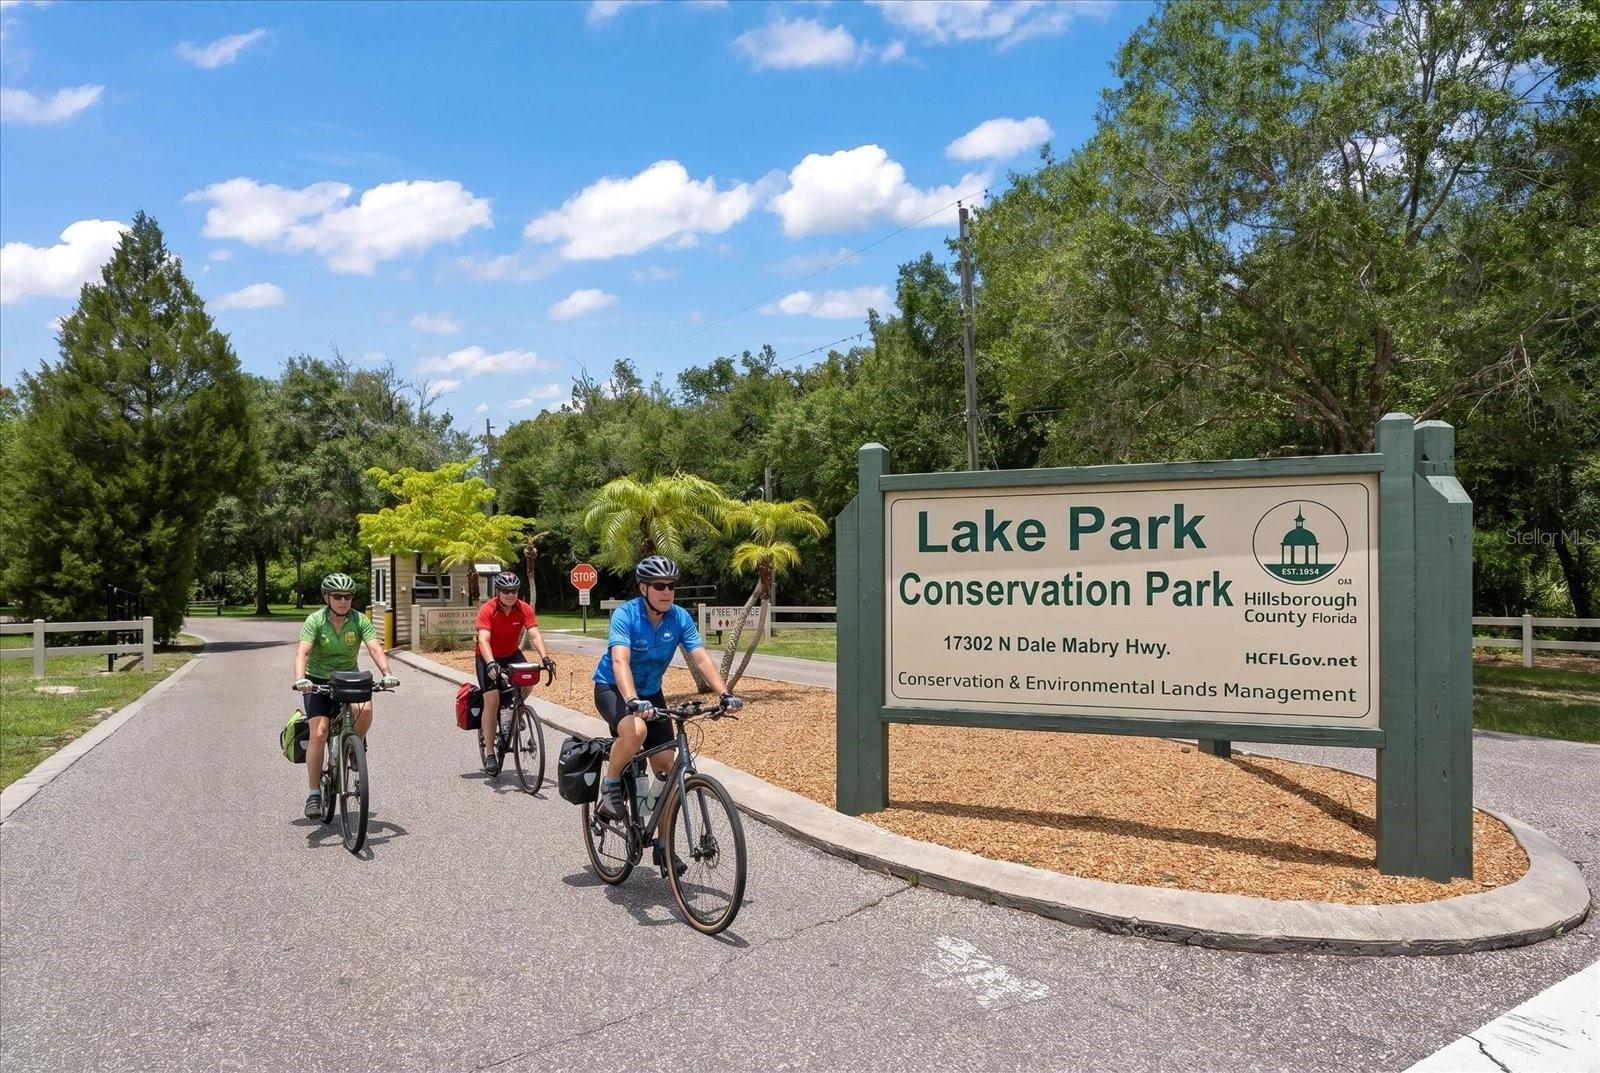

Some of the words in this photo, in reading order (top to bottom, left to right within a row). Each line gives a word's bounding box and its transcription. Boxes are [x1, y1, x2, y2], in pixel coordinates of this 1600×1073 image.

[918, 508, 1047, 554] Lake
[1069, 503, 1208, 551] Park
[573, 572, 596, 582] STOP
[899, 571, 1131, 607] Conservation
[1146, 570, 1234, 607] Park
[1244, 591, 1358, 610] Hillsborough
[1244, 609, 1307, 628] County
[1312, 612, 1358, 625] Florida
[943, 635, 993, 652] 17302
[998, 636, 1011, 652] N
[1017, 636, 1057, 653] Dale
[1062, 637, 1120, 658] Mabry
[1126, 638, 1171, 660] Hwy.
[1245, 652, 1358, 668] HCFLGov.net
[898, 671, 1004, 690] Conservation
[1009, 675, 1021, 690] &
[1026, 675, 1155, 696] Environmental
[1161, 680, 1218, 698] Lands
[1224, 682, 1358, 705] Management
